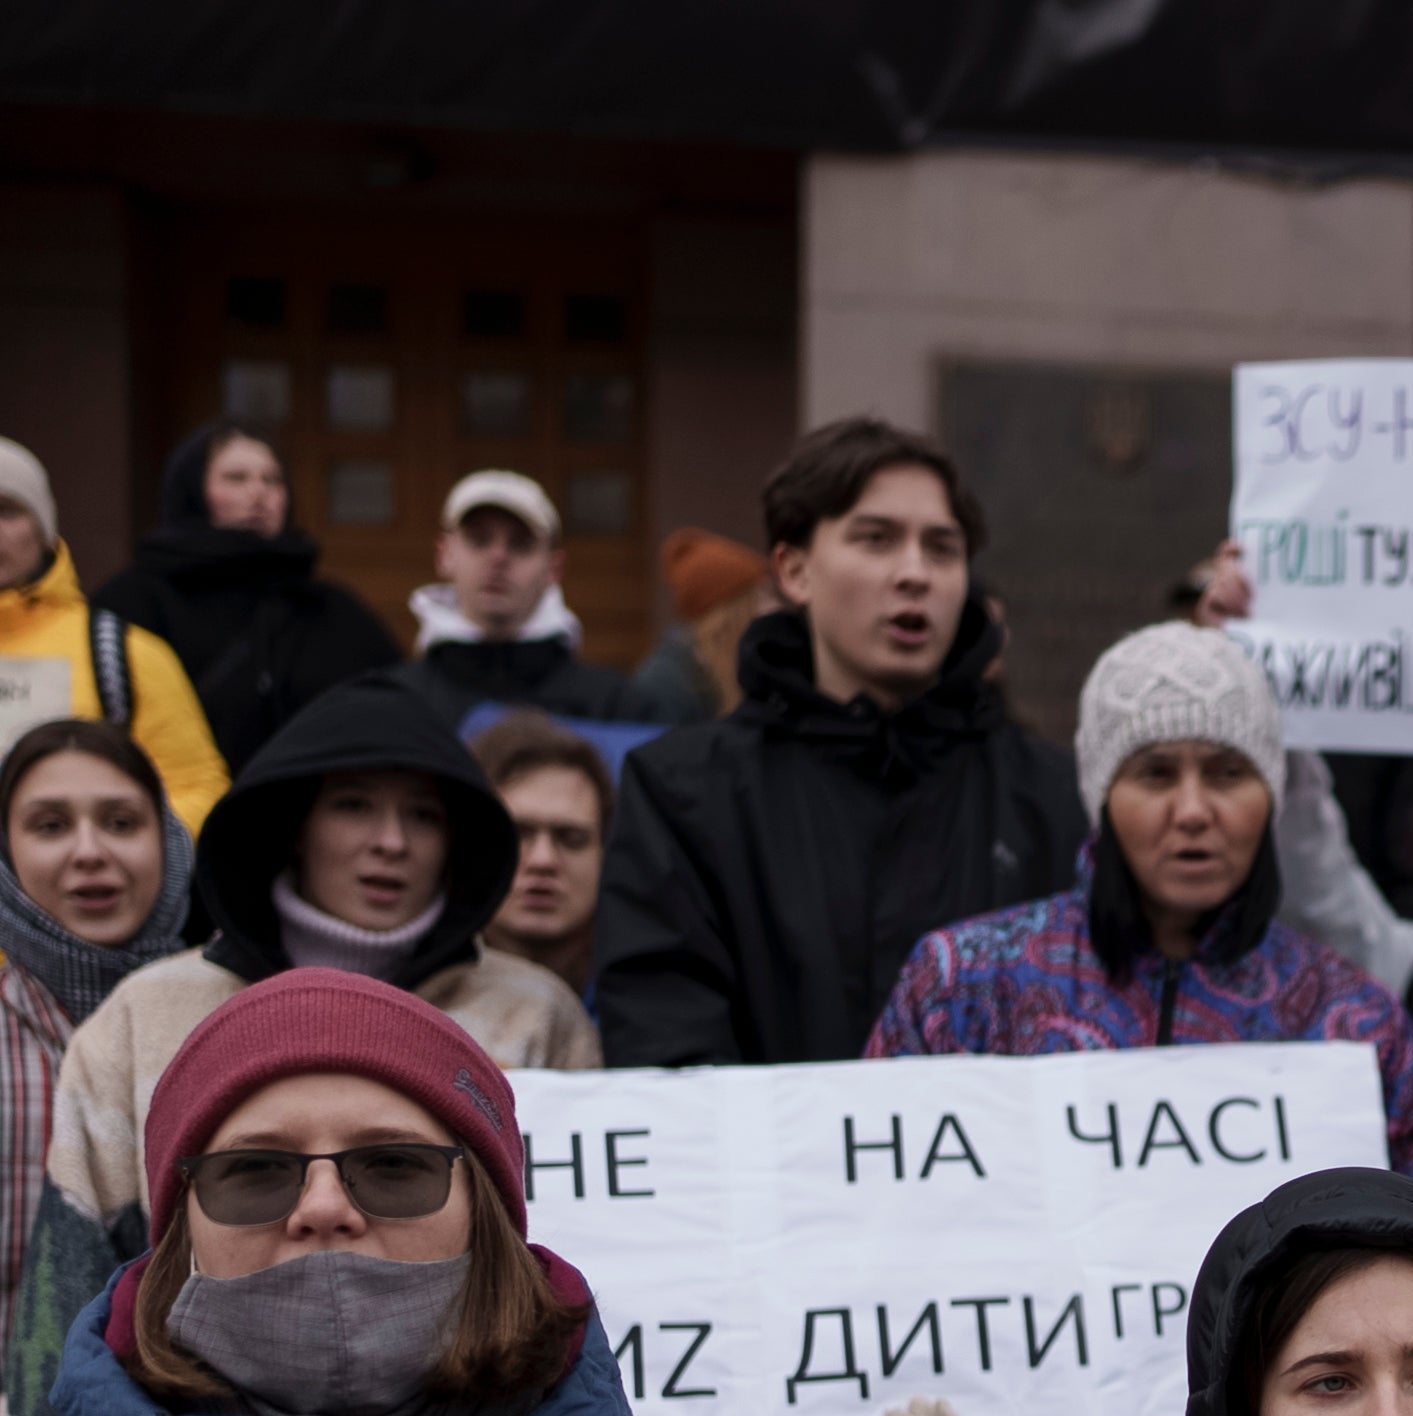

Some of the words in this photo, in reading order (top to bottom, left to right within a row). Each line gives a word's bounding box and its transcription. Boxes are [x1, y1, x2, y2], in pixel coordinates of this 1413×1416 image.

[525, 1128, 656, 1202] НЕ
[842, 1112, 988, 1184] НА
[1065, 1094, 1291, 1169] ЧАСІ
[786, 1293, 1090, 1405] ДИТИ
